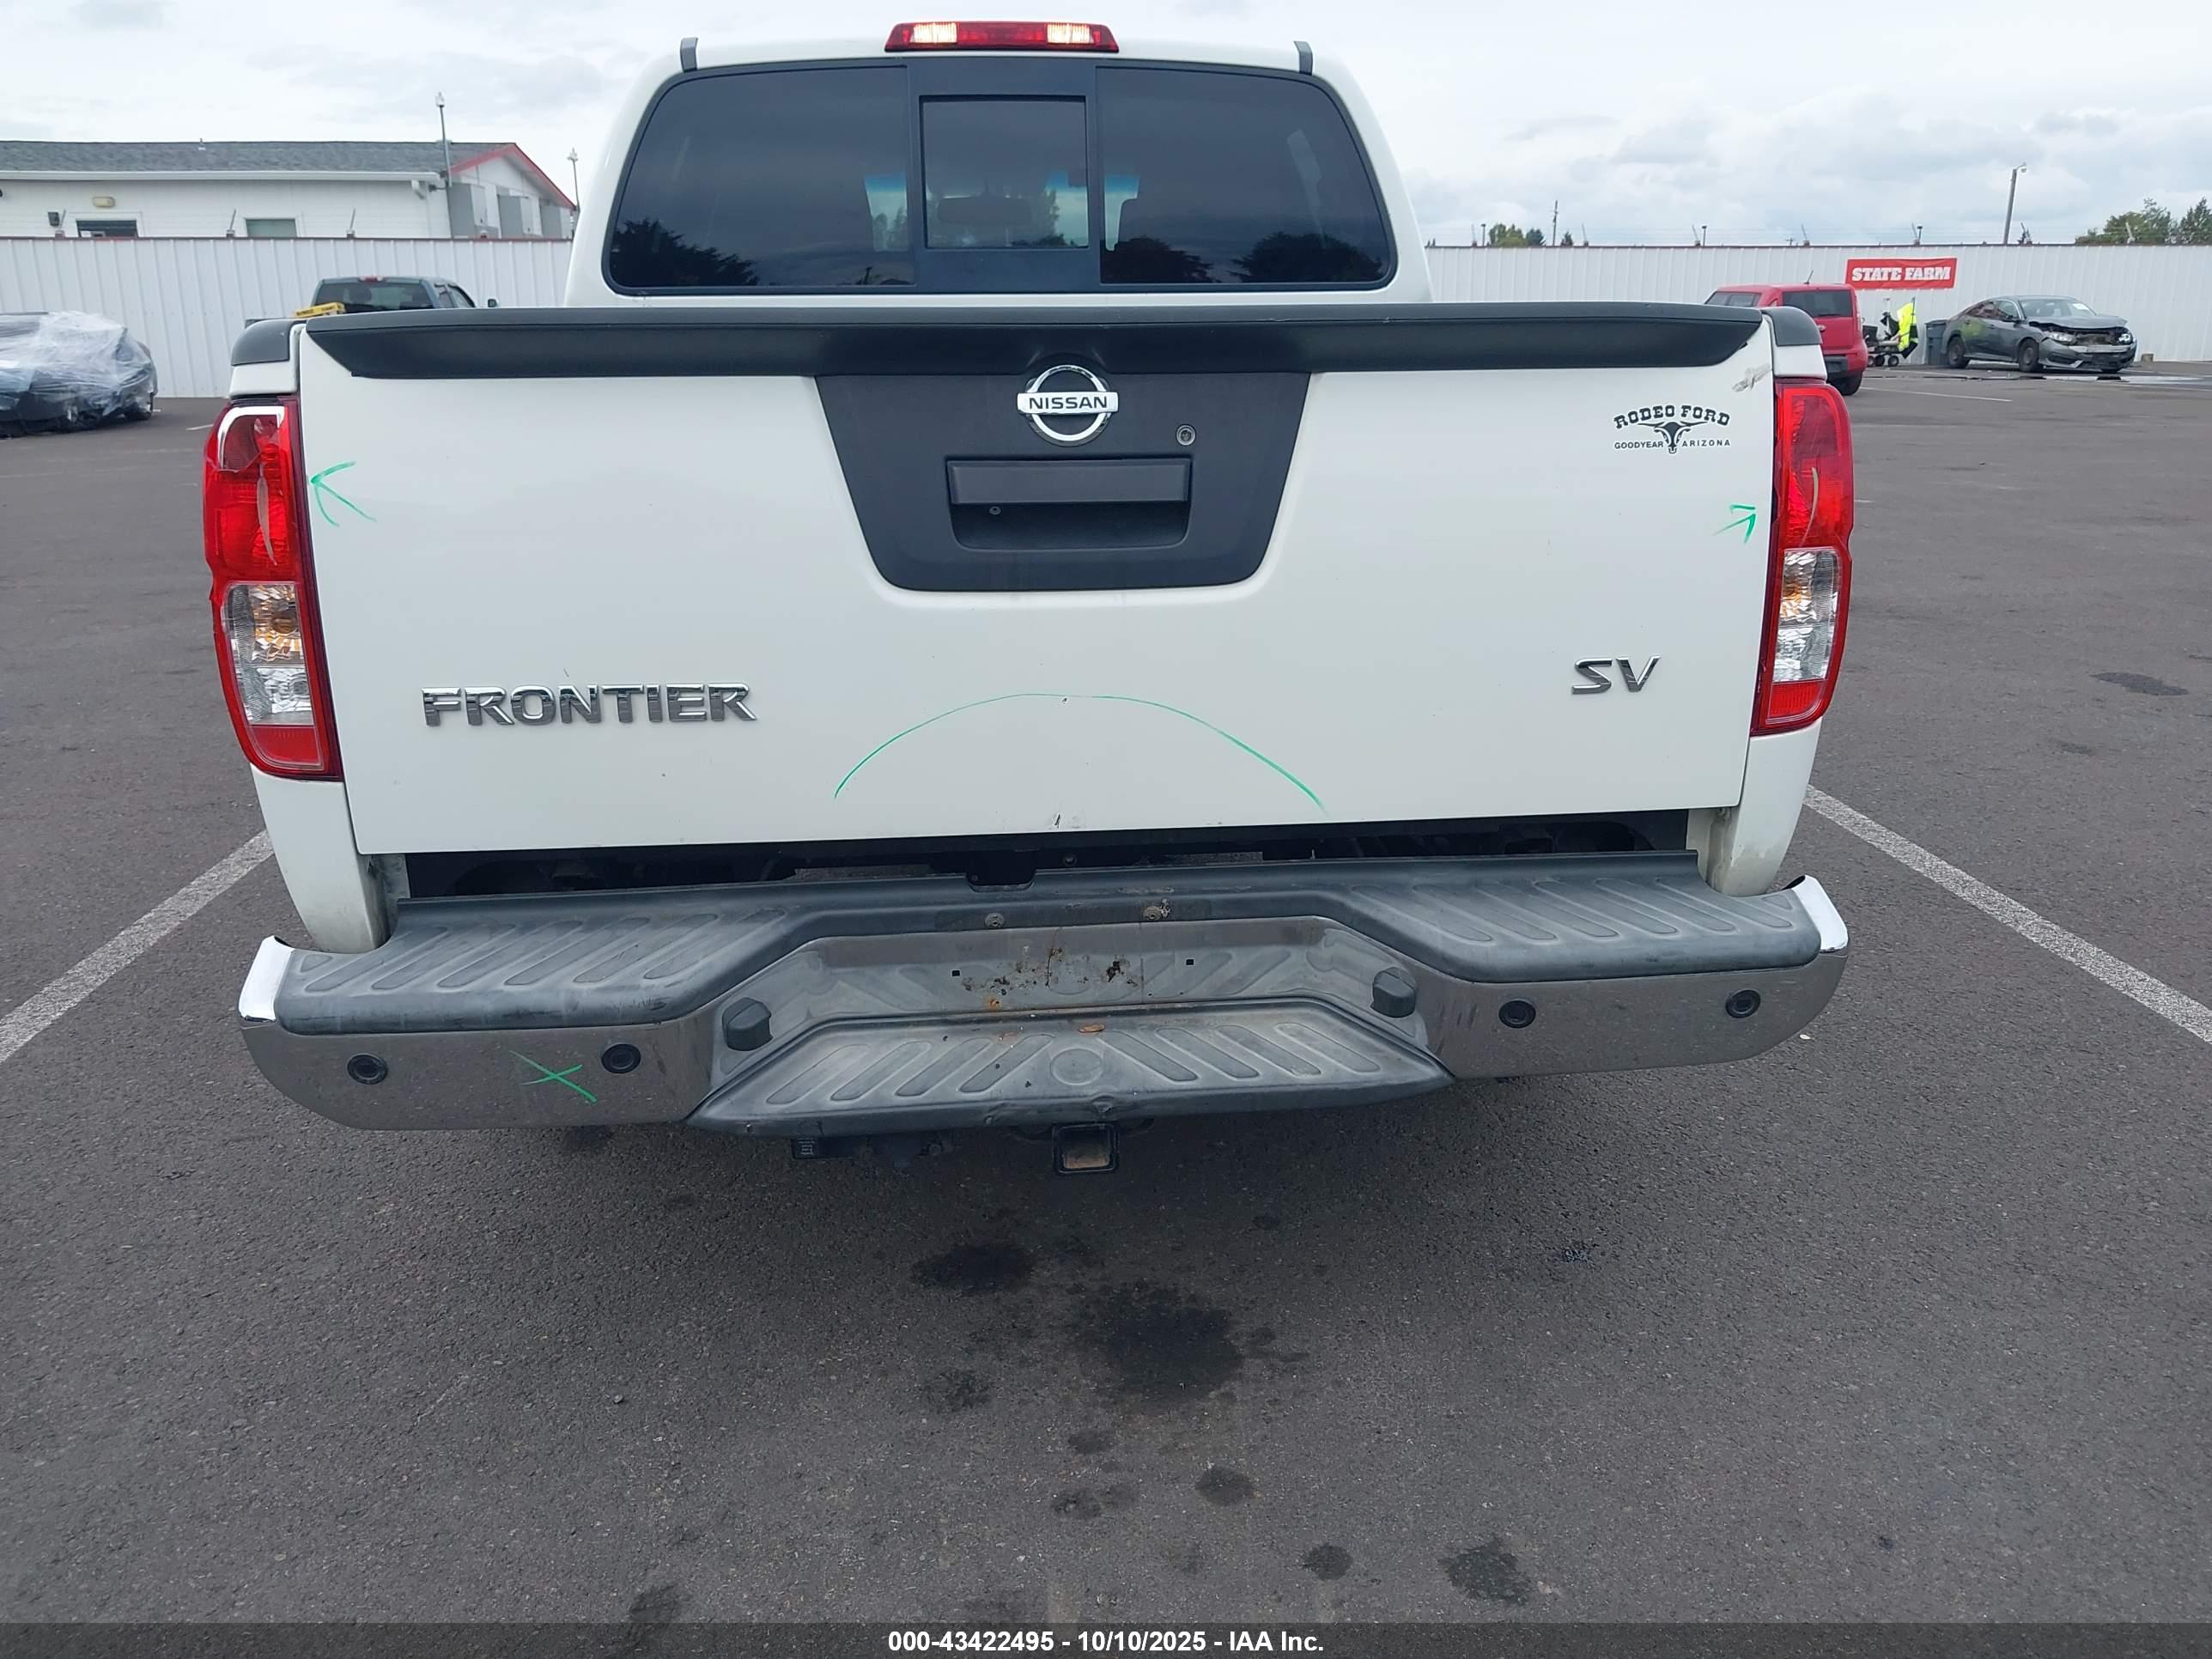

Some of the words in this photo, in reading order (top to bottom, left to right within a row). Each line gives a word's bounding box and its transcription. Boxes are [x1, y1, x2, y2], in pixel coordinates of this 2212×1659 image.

[1851, 267, 1902, 282] STATE
[1905, 266, 1952, 281] FARM
[1029, 396, 1108, 410] NISSAN
[1613, 404, 1675, 429] RODEO
[1680, 404, 1731, 427] FORD
[1614, 441, 1664, 450] GOODYEAR
[1681, 439, 1731, 447] ARIZONA
[1571, 654, 1662, 696] SV
[421, 682, 758, 727] FRONTIER
